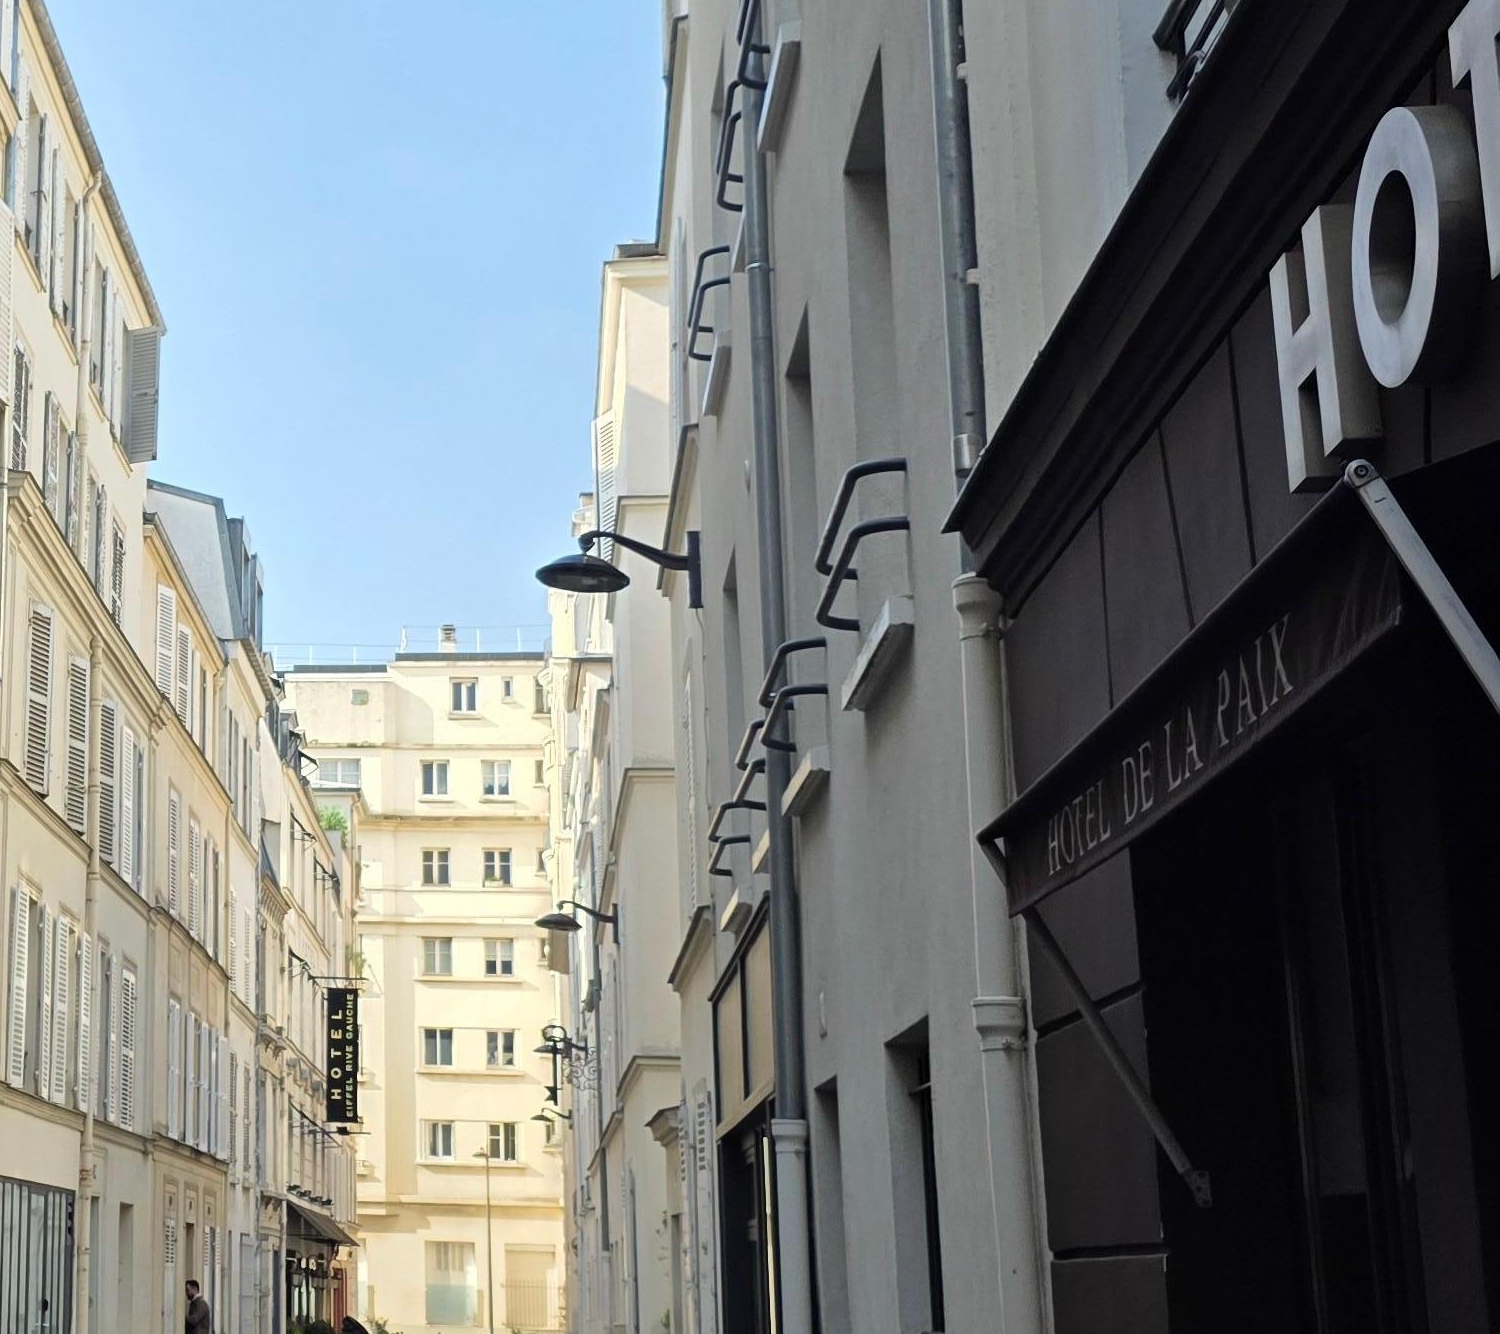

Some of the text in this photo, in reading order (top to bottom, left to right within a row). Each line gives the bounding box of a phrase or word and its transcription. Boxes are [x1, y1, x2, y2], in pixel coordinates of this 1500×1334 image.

[1048, 612, 1295, 876] HOTEL DE LA PAIX
[330, 1009, 343, 1100] HOTEL
[345, 993, 354, 1117] EIFFEL RIVE GAUCHE
